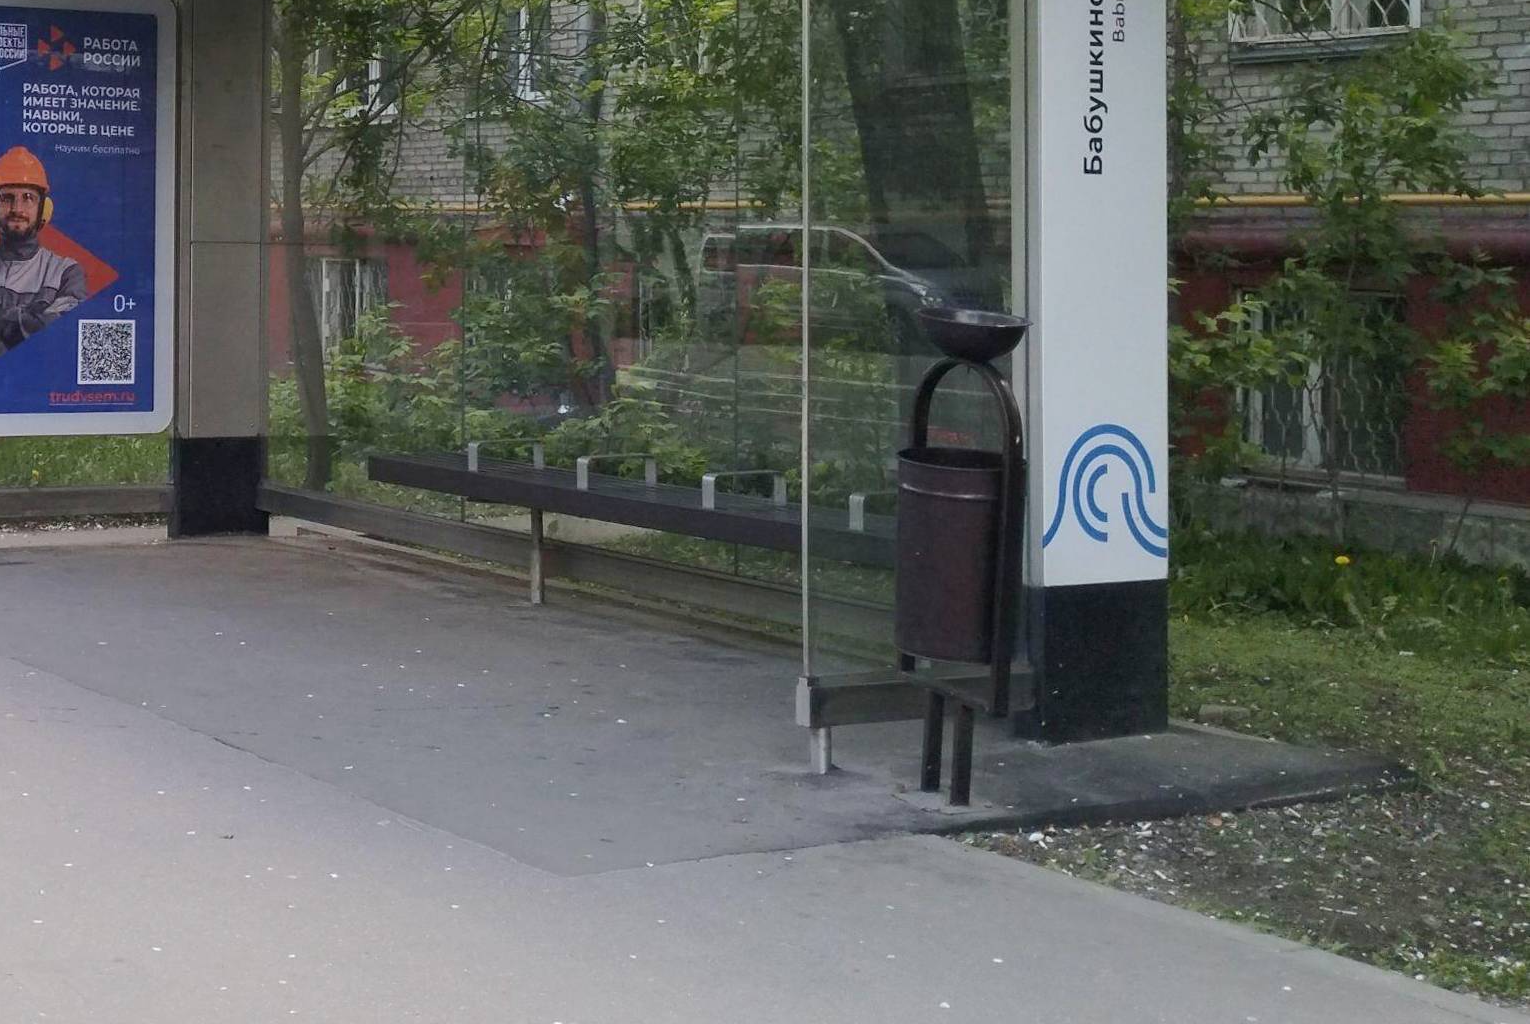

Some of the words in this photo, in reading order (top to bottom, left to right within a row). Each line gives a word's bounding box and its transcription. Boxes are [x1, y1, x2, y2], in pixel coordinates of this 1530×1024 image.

[83, 37, 138, 52] РАБОТА
[83, 52, 141, 67] РОССИИ
[22, 83, 79, 97] РАБОТА,
[81, 85, 141, 99] КОТОРАЯ
[22, 96, 67, 108] ИМЕЕТ
[70, 98, 141, 111] ЗНАЧЕНИЕ.
[22, 109, 84, 123] НАВЫКИ,
[22, 122, 86, 135] КОТОРЫЕ
[89, 125, 98, 136] В
[100, 125, 135, 137] ЦЕНЕ
[113, 294, 137, 313] 0+
